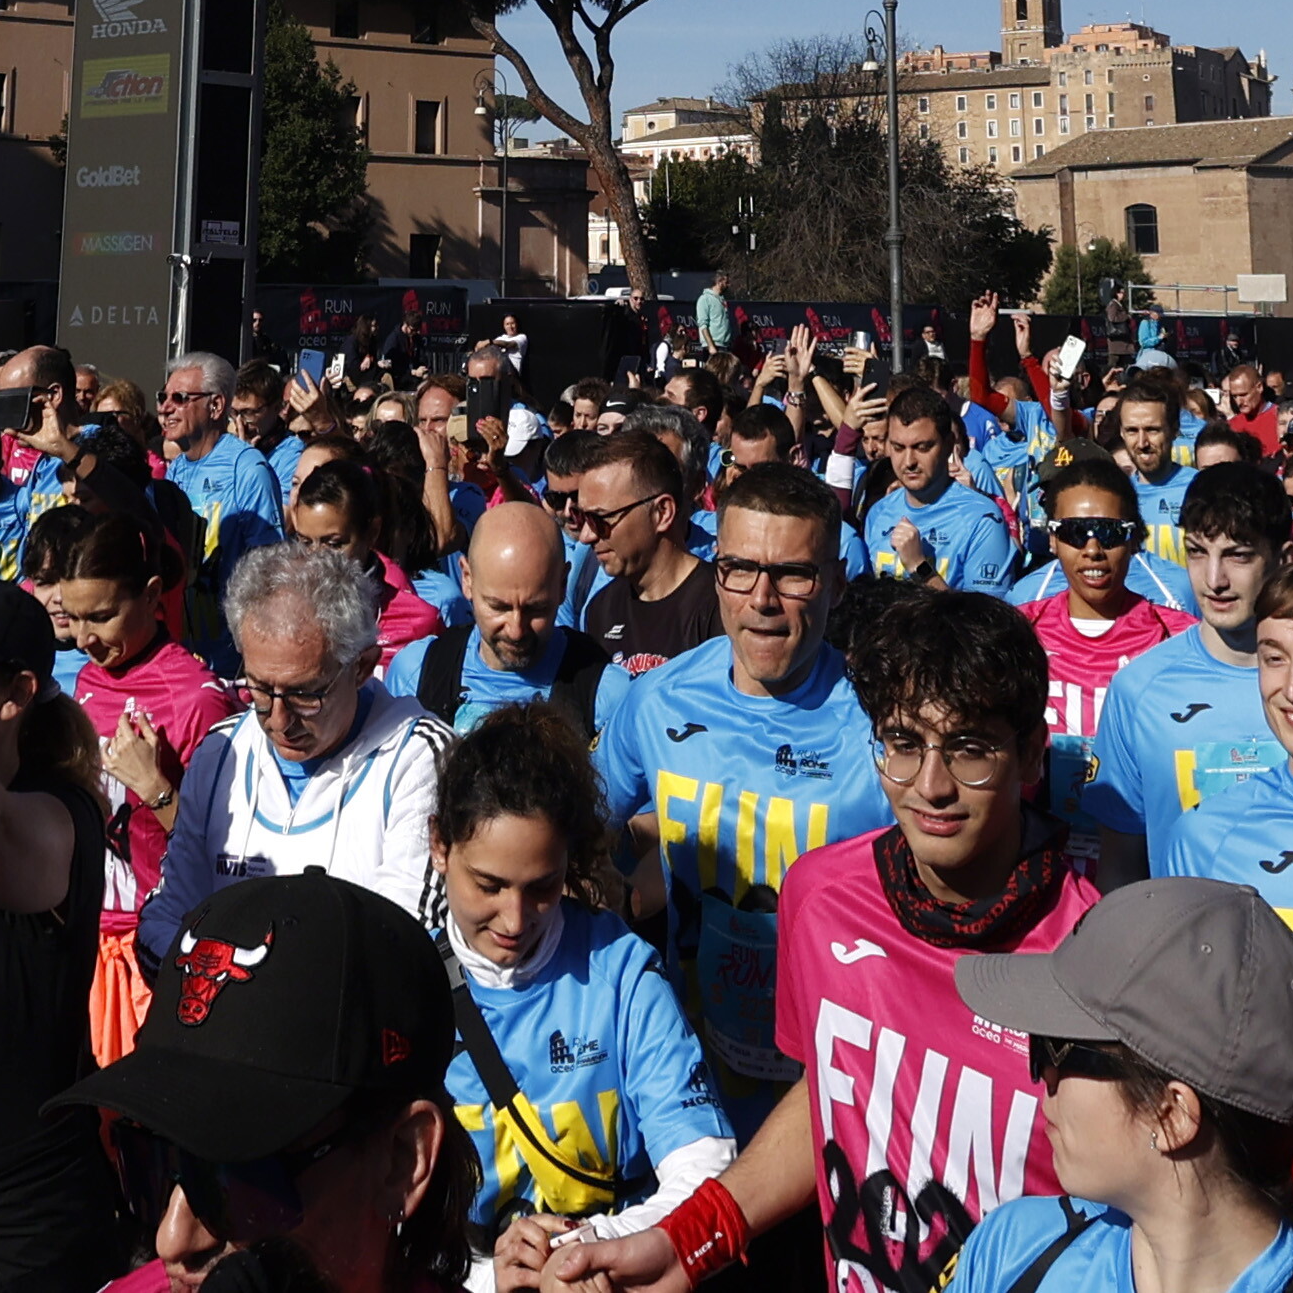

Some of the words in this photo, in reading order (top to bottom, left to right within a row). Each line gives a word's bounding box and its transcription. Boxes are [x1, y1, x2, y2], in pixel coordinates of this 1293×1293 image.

[91, 18, 168, 39] HONDA
[76, 165, 141, 188] GoldBet
[80, 233, 153, 253] MASSIGEN
[91, 305, 159, 325] DELTA
[324, 299, 353, 314] RUN
[426, 302, 451, 315] RUN
[822, 314, 842, 327] RUN
[657, 768, 829, 908] FUN
[972, 1025, 1001, 1044] acea
[815, 997, 1039, 1243] FUN
